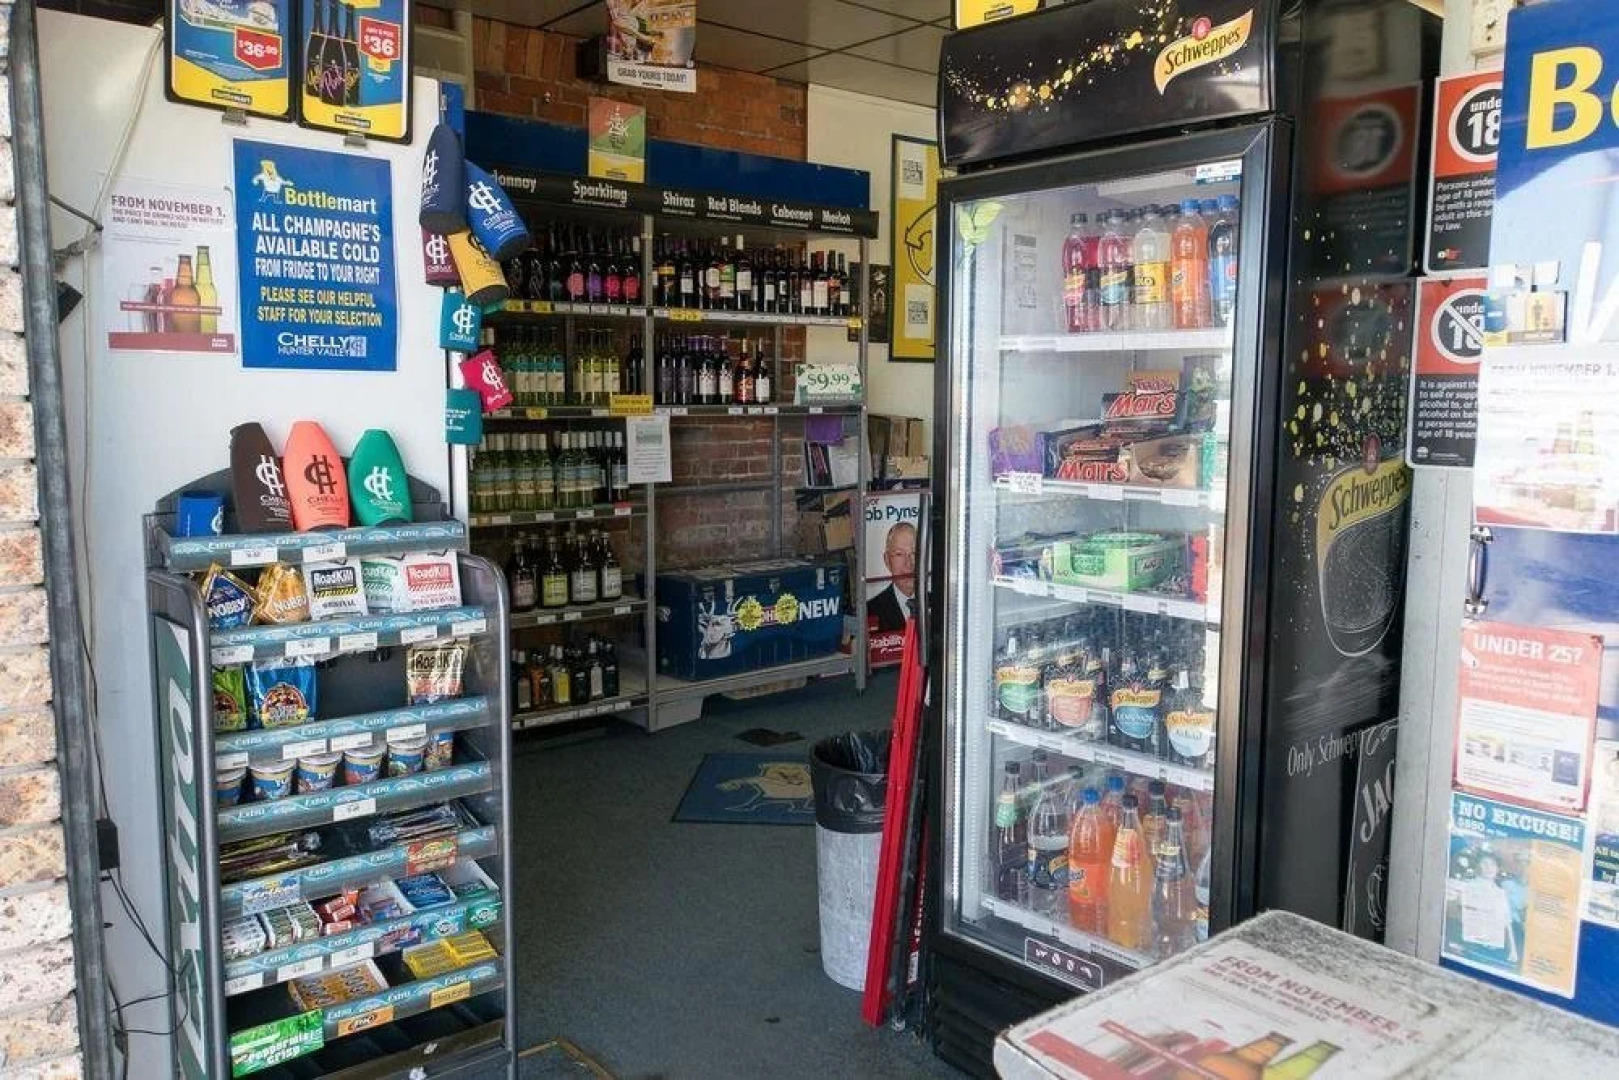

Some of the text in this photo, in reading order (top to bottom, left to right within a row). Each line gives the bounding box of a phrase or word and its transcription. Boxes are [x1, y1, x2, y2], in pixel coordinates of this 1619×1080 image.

[1165, 25, 1241, 75] Schweppes
[1470, 96, 1501, 111] unde
[284, 187, 377, 214] Bottlemart
[573, 180, 628, 204] Sparkling
[663, 191, 695, 208] Shiraz
[111, 195, 145, 208] FROM
[148, 198, 213, 217] NOVEMBER
[708, 196, 762, 215] Red Blends
[772, 203, 813, 220] Cabernet
[252, 211, 381, 242] ALL CHAMPAGNE'S
[256, 235, 380, 263] AVAILABLE COLD
[255, 257, 380, 286] FROM FRIDGE TO YOUR RIGHT
[261, 286, 376, 308] PLEASE SEE OUR HELPFUL
[258, 306, 382, 328] STAFF FOR YOUR SELECTION
[277, 332, 349, 348] CHELLY
[1107, 393, 1177, 417] Mars
[1056, 459, 1129, 482] Mars
[1329, 467, 1407, 530] Schweppes
[313, 569, 354, 585] RoadKill
[409, 565, 449, 580] RoadKill
[208, 597, 246, 619] NOBBY
[799, 596, 840, 621] NEW
[1476, 633, 1584, 665] UNDER 25?
[1288, 742, 1314, 777] Only
[1458, 799, 1580, 843] NO EXCUSE!
[1220, 956, 1280, 983] FROM
[1279, 978, 1401, 1033] NOVEMBER
